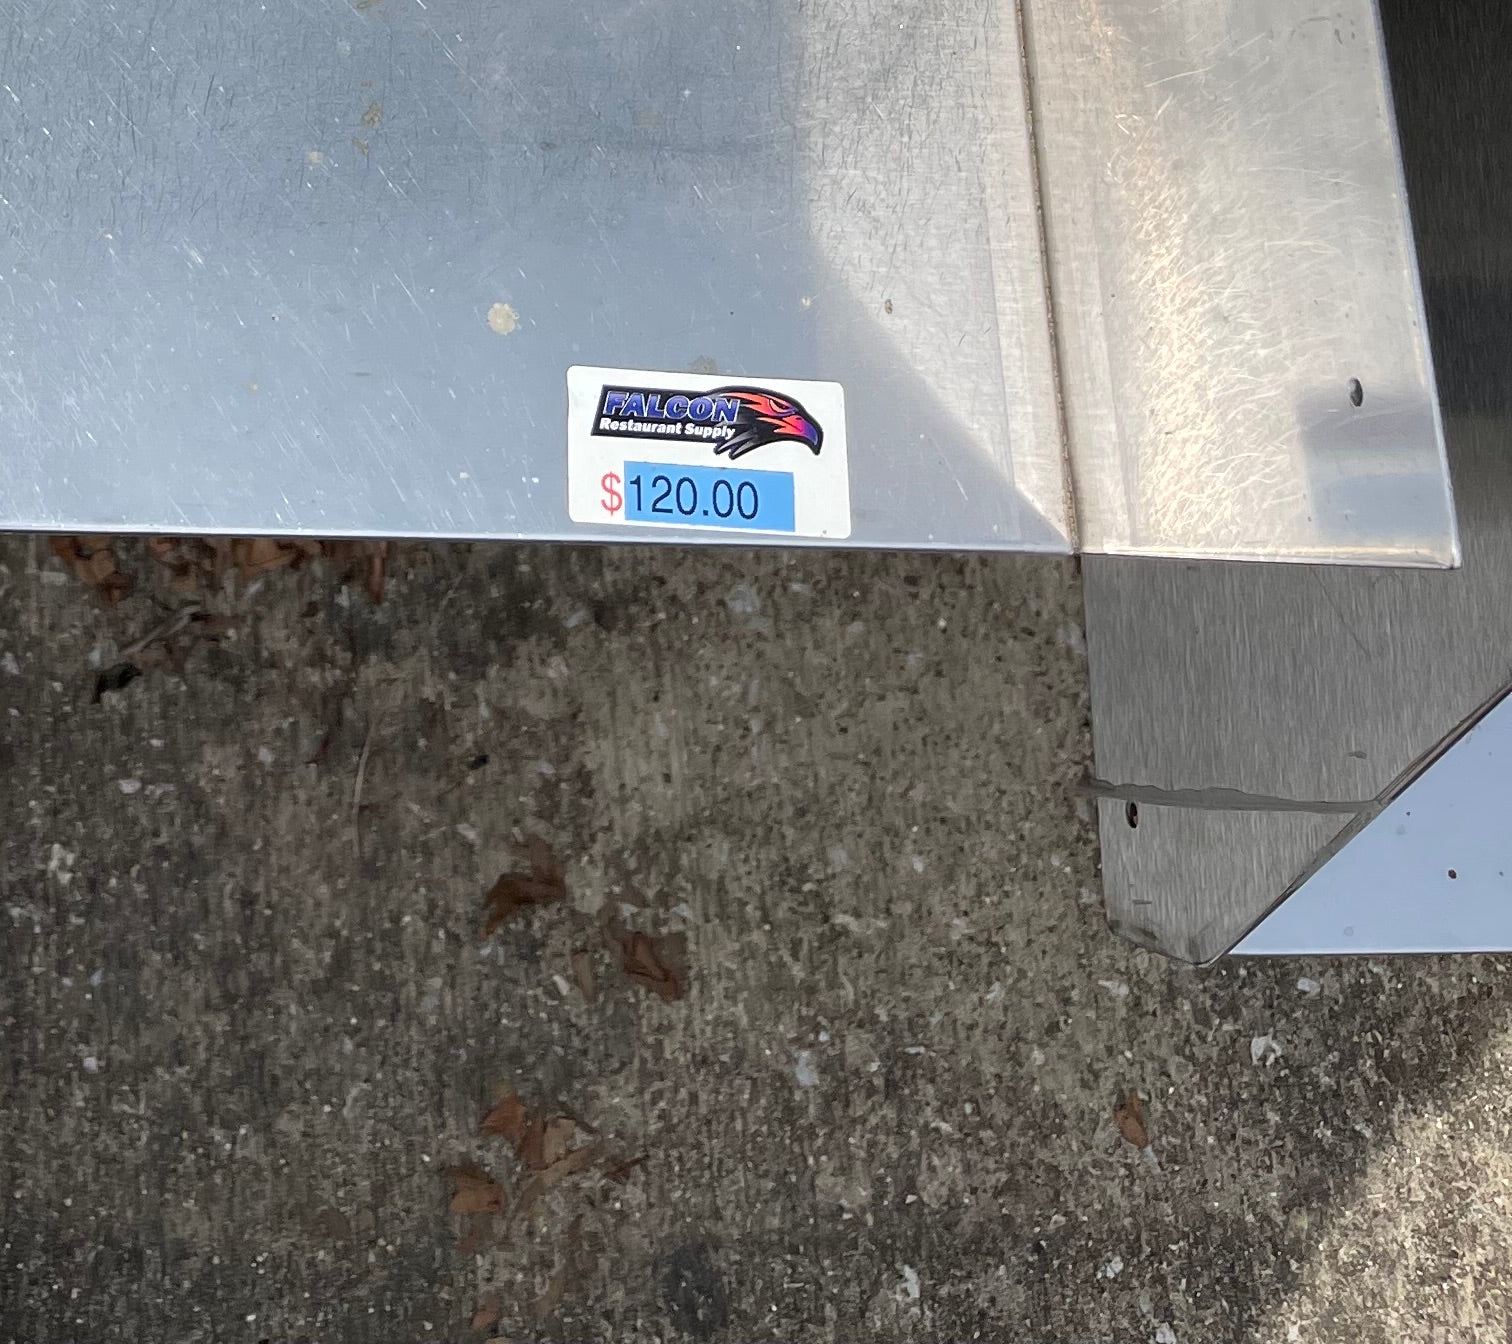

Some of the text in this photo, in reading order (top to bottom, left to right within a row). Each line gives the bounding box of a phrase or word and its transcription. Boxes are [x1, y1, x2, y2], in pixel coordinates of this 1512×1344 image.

[604, 390, 740, 423] FALCON
[599, 417, 736, 440] Restaurant Supply
[600, 471, 759, 520] $120.00
